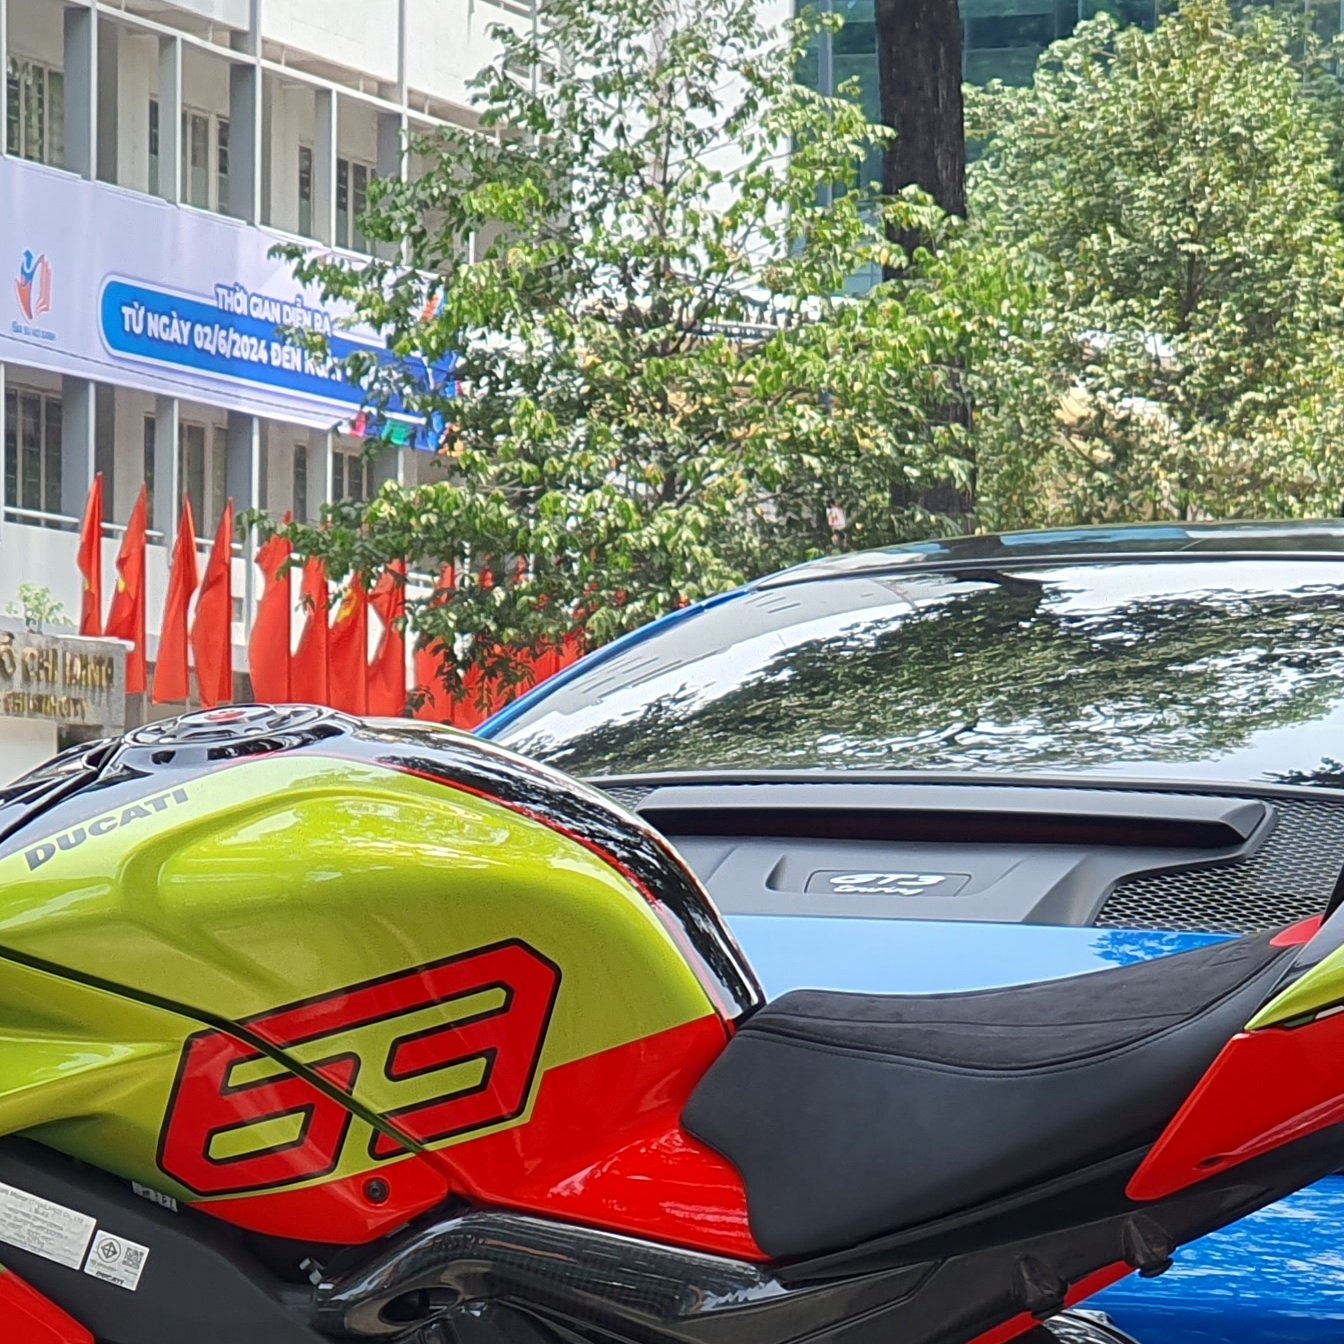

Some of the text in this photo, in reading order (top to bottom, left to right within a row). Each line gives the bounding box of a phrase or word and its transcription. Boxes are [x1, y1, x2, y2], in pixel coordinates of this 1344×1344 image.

[215, 283, 248, 317] THỜI
[249, 293, 281, 325] GIAN
[121, 301, 145, 335] TỪ
[147, 310, 192, 346] NGÀY
[193, 324, 268, 365] 02/6/2024
[24, 787, 189, 871] DUCATI
[829, 873, 947, 887] GT3
